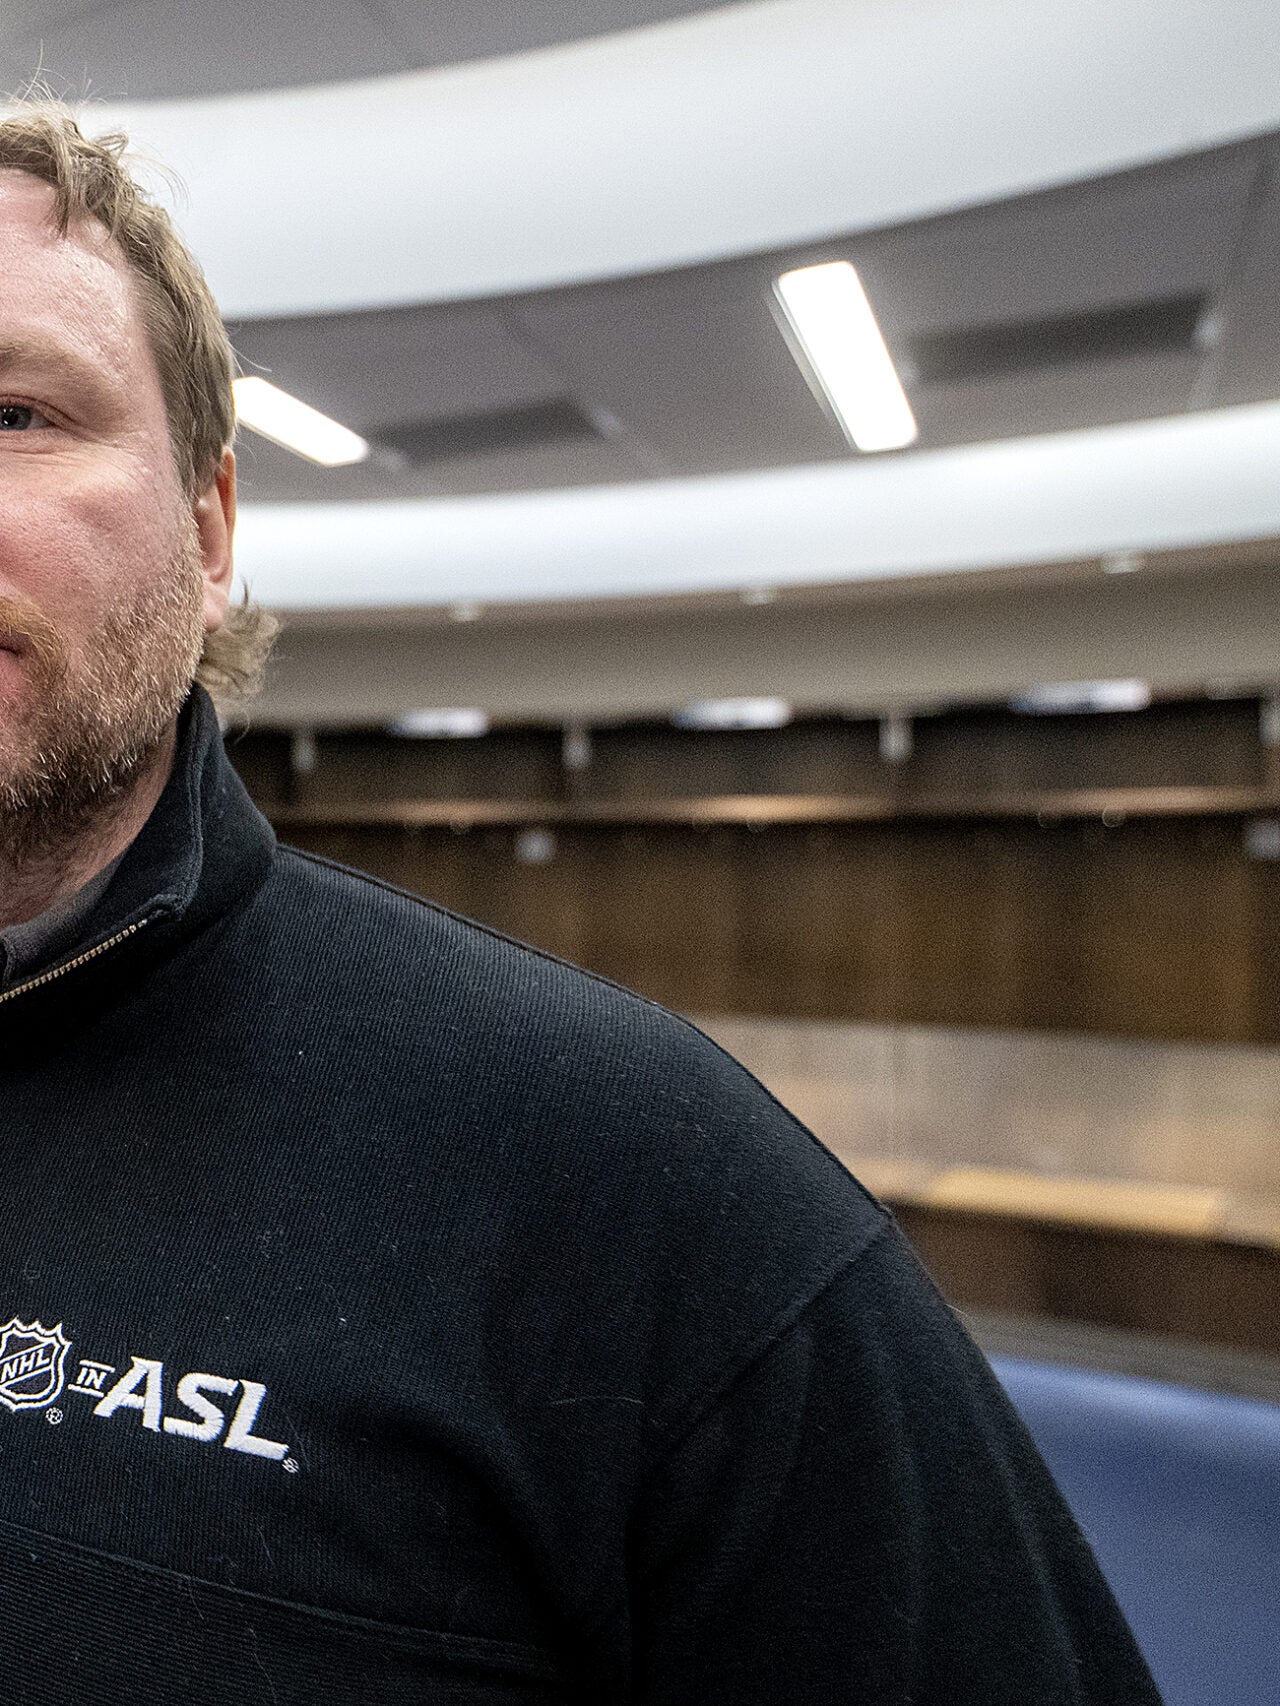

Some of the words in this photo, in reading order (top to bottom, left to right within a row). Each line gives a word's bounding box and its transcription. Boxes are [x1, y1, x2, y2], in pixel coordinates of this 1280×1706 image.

[0, 1347, 51, 1383] NHL
[77, 1365, 108, 1390] IN
[93, 1356, 290, 1461] ASL
